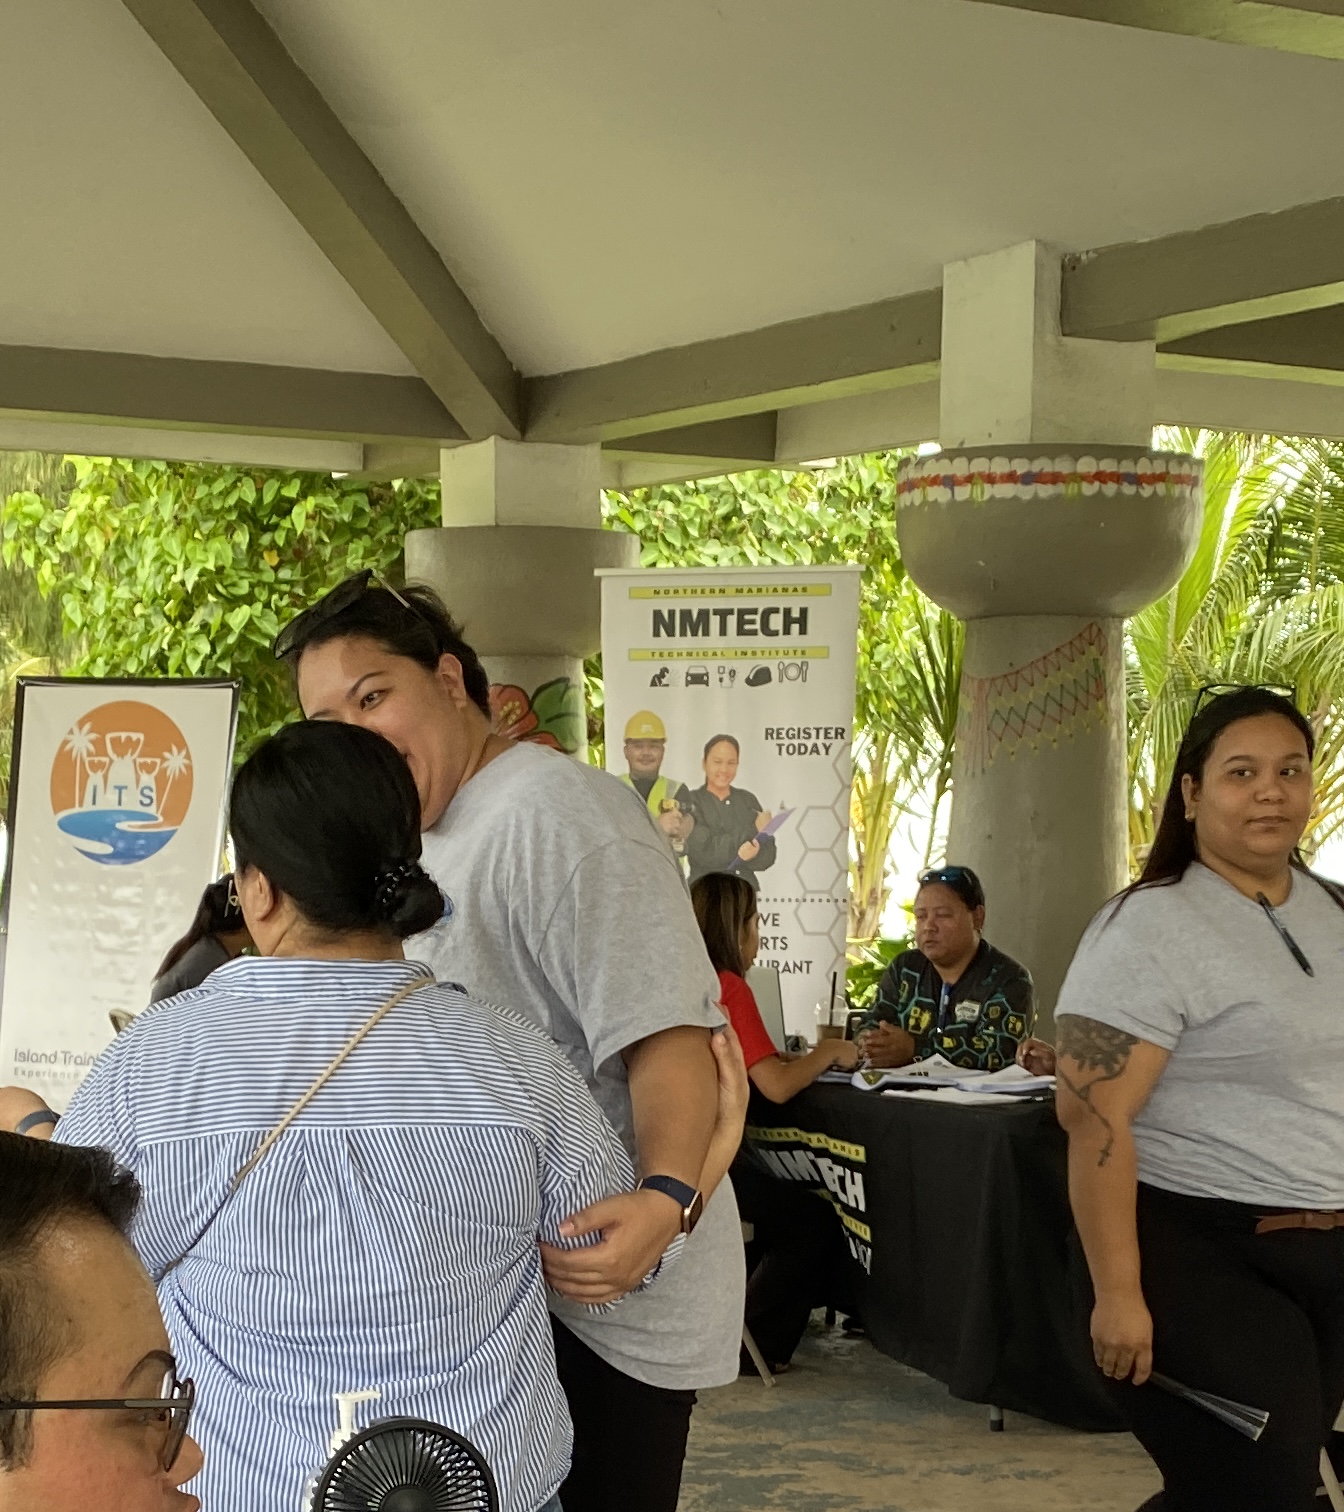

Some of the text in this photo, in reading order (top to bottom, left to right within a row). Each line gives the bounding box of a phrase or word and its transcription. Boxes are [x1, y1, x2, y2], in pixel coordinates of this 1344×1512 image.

[653, 586, 809, 596] NORTHERN MARIANAS
[652, 606, 809, 638] NMTECH
[651, 649, 807, 658] TECHNICAL INSTITUTE
[764, 727, 846, 740] REGISTER
[776, 742, 833, 756] TODAY
[60, 1050, 99, 1066] Train
